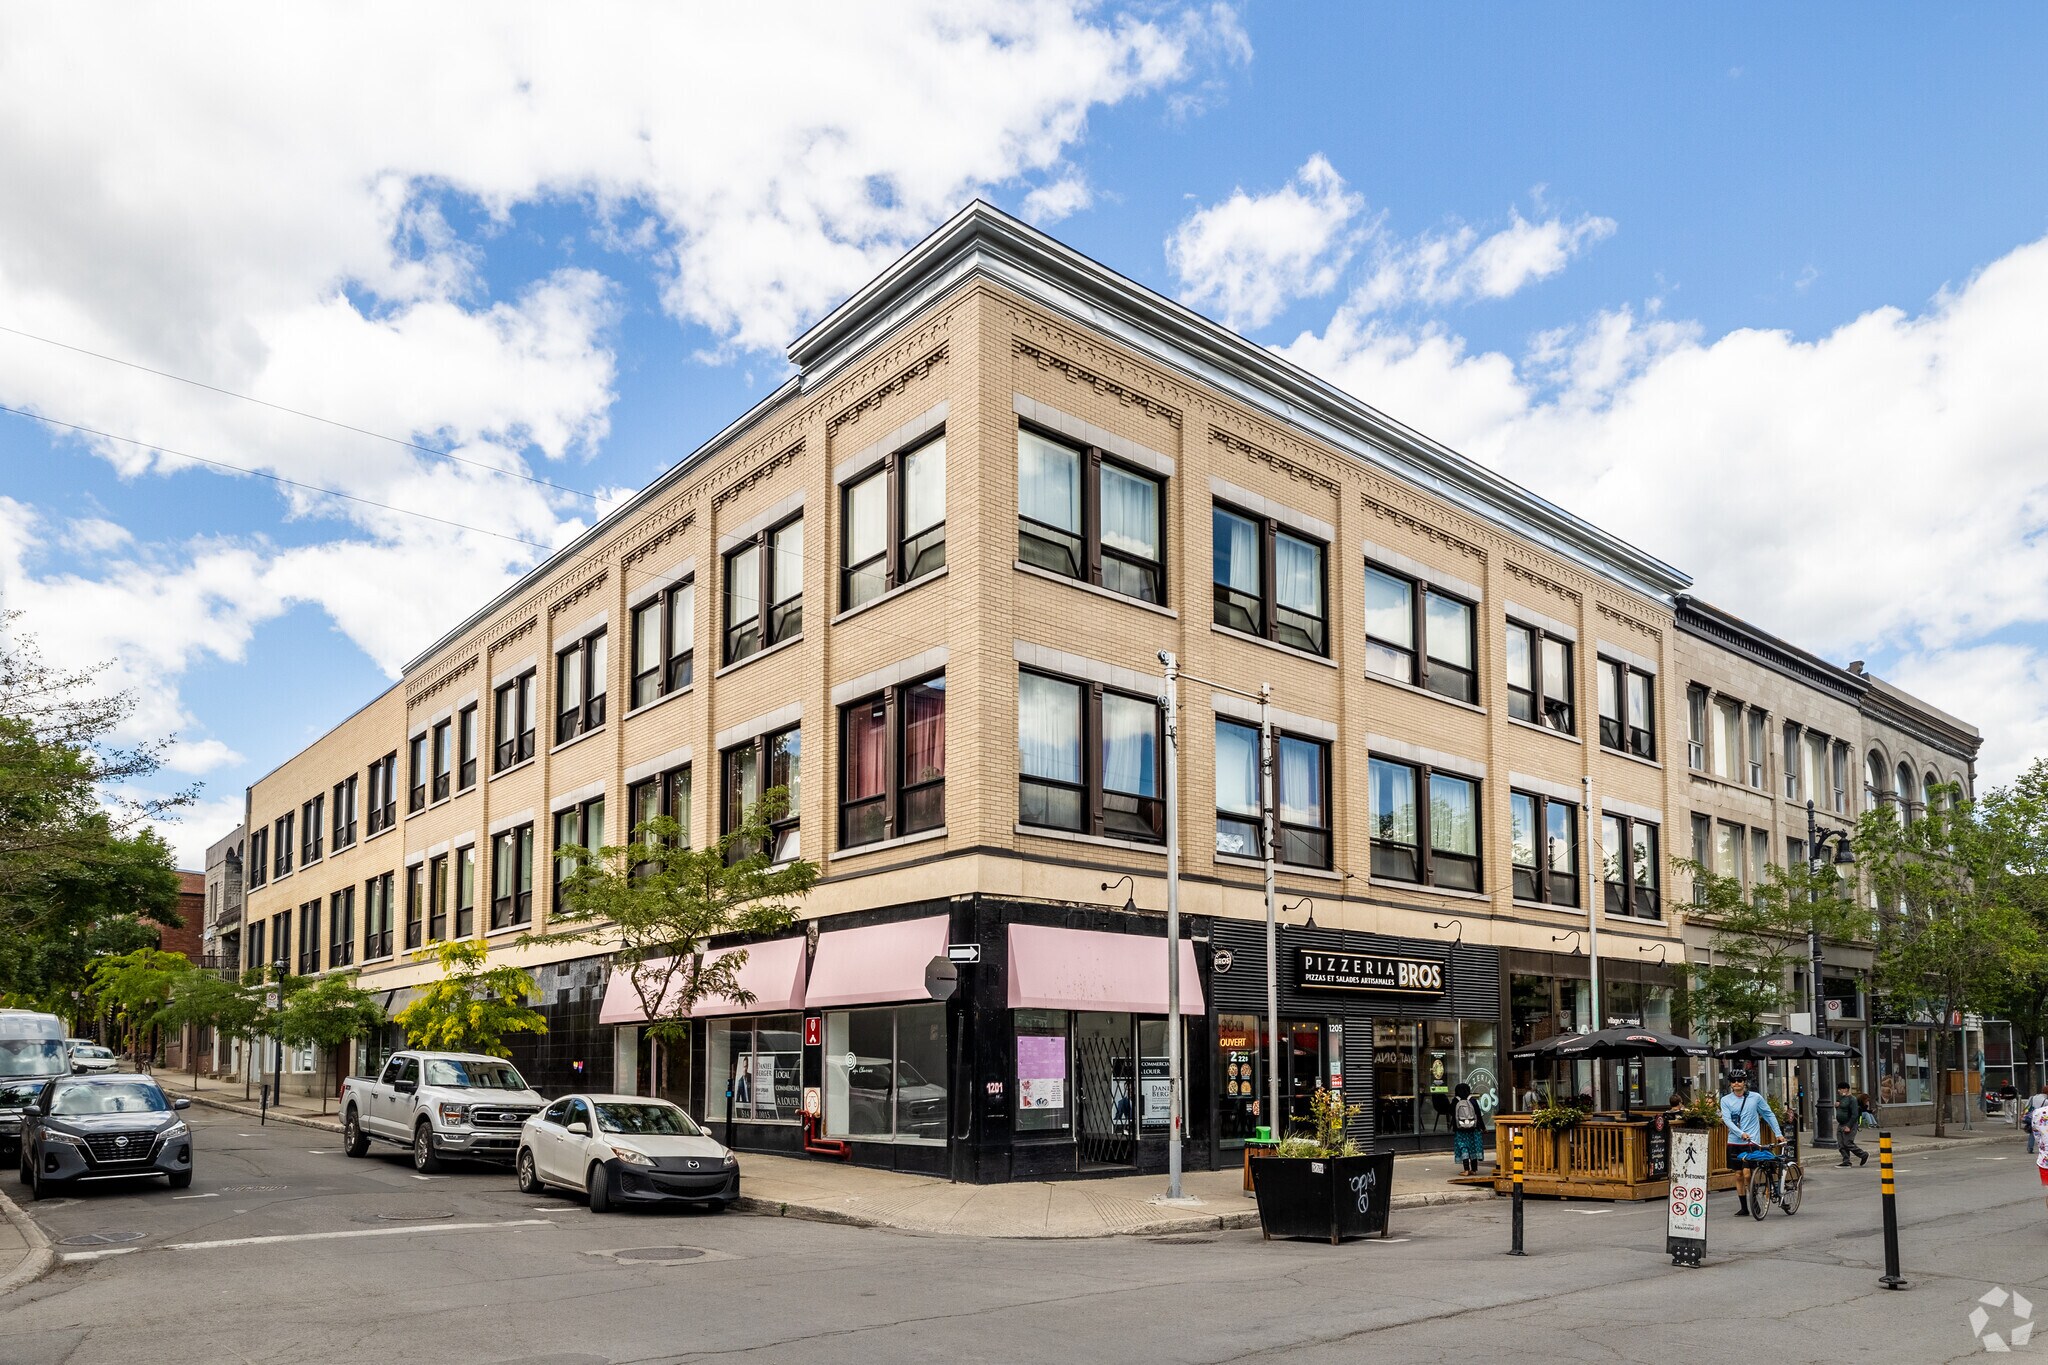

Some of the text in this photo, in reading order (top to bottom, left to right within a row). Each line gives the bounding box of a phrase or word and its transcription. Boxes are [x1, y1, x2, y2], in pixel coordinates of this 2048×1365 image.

[1305, 956, 1395, 976] PIZZERIA
[1305, 973, 1395, 986] PIZZAS ET SALADES ARTISANALES
[1398, 962, 1442, 989] BROS
[1328, 1024, 1343, 1032] 1205
[1219, 1038, 1247, 1047] OUVERT
[1230, 1051, 1238, 1062] 2
[775, 1070, 790, 1079] LOCAL
[775, 1084, 800, 1092] COMMERCIAL
[986, 1082, 1003, 1094] 1201
[781, 1096, 800, 1106] LOUER
